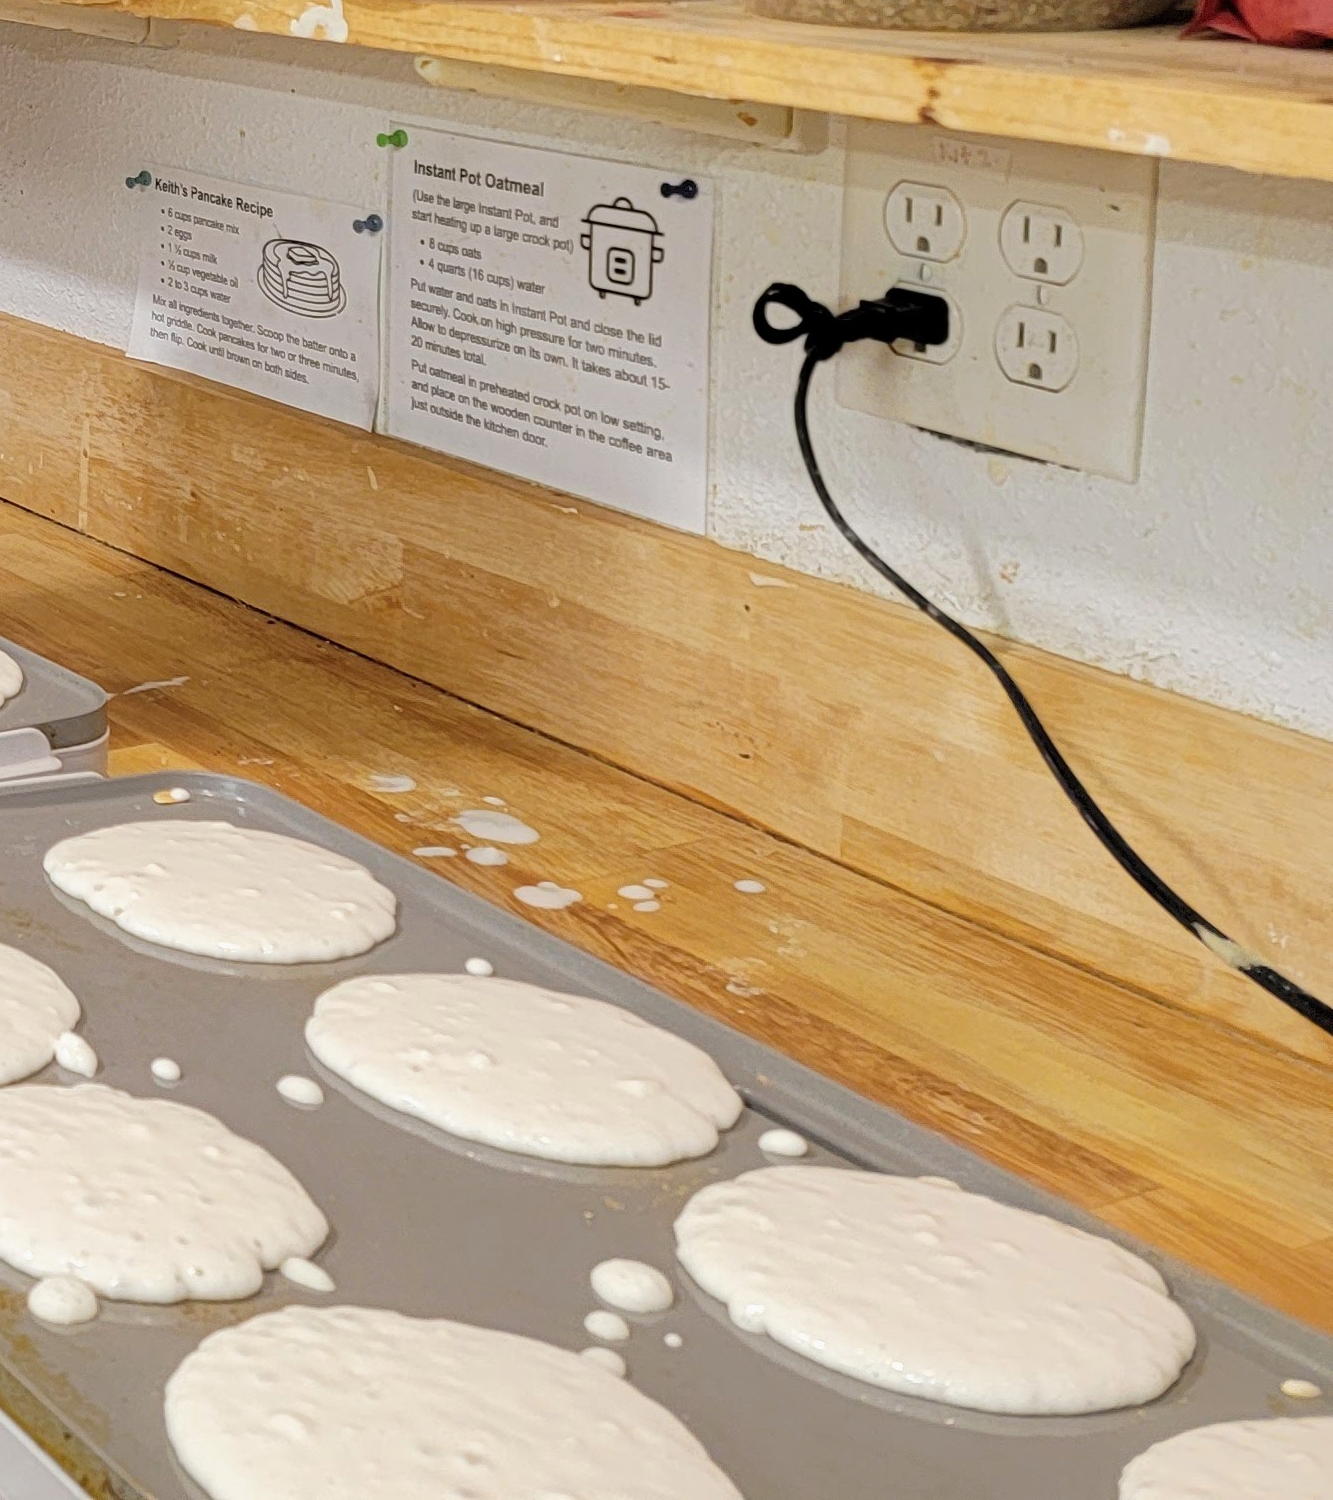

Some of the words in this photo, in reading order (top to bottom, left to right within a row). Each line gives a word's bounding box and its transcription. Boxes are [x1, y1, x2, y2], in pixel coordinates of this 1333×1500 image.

[414, 160, 456, 181] Instant
[460, 169, 481, 186] Pot
[485, 173, 544, 197] Oatmeal
[155, 178, 188, 197] Keith's
[191, 186, 233, 208] Pancake
[236, 198, 273, 218] Recipe
[413, 189, 434, 203] (Use
[437, 193, 450, 208] the
[453, 197, 475, 214] large
[479, 203, 512, 220] Instant
[539, 215, 559, 228] and
[168, 208, 173, 217] 6
[175, 211, 191, 222] cups
[194, 216, 224, 231] pancake
[226, 224, 239, 235] mix
[168, 225, 173, 235] 2
[175, 228, 192, 242] eggs
[412, 209, 432, 222] start
[434, 212, 467, 233] heating
[470, 223, 482, 236] up
[485, 226, 490, 235] a
[494, 225, 519, 242] large
[522, 233, 550, 247] crock
[553, 239, 574, 255] pot)
[183, 250, 201, 261] cups
[203, 254, 217, 264] milk
[429, 238, 435, 249] 8
[438, 241, 459, 256] cups
[462, 248, 482, 260] oats
[168, 277, 173, 287] 2
[175, 279, 182, 290] to
[184, 282, 188, 291] 3
[191, 285, 208, 298] cups
[210, 292, 231, 303] water
[177, 264, 190, 276] cup
[192, 268, 228, 285] vegetable
[230, 278, 238, 288] oil
[428, 258, 434, 270] 4
[437, 262, 466, 277] quarts
[469, 266, 484, 282] (16
[487, 274, 514, 290] cups)
[517, 279, 545, 294] water
[411, 397, 428, 410] just
[430, 402, 463, 423] outside
[466, 413, 481, 427] the
[484, 418, 519, 438] kitchen
[522, 431, 547, 448] door.
